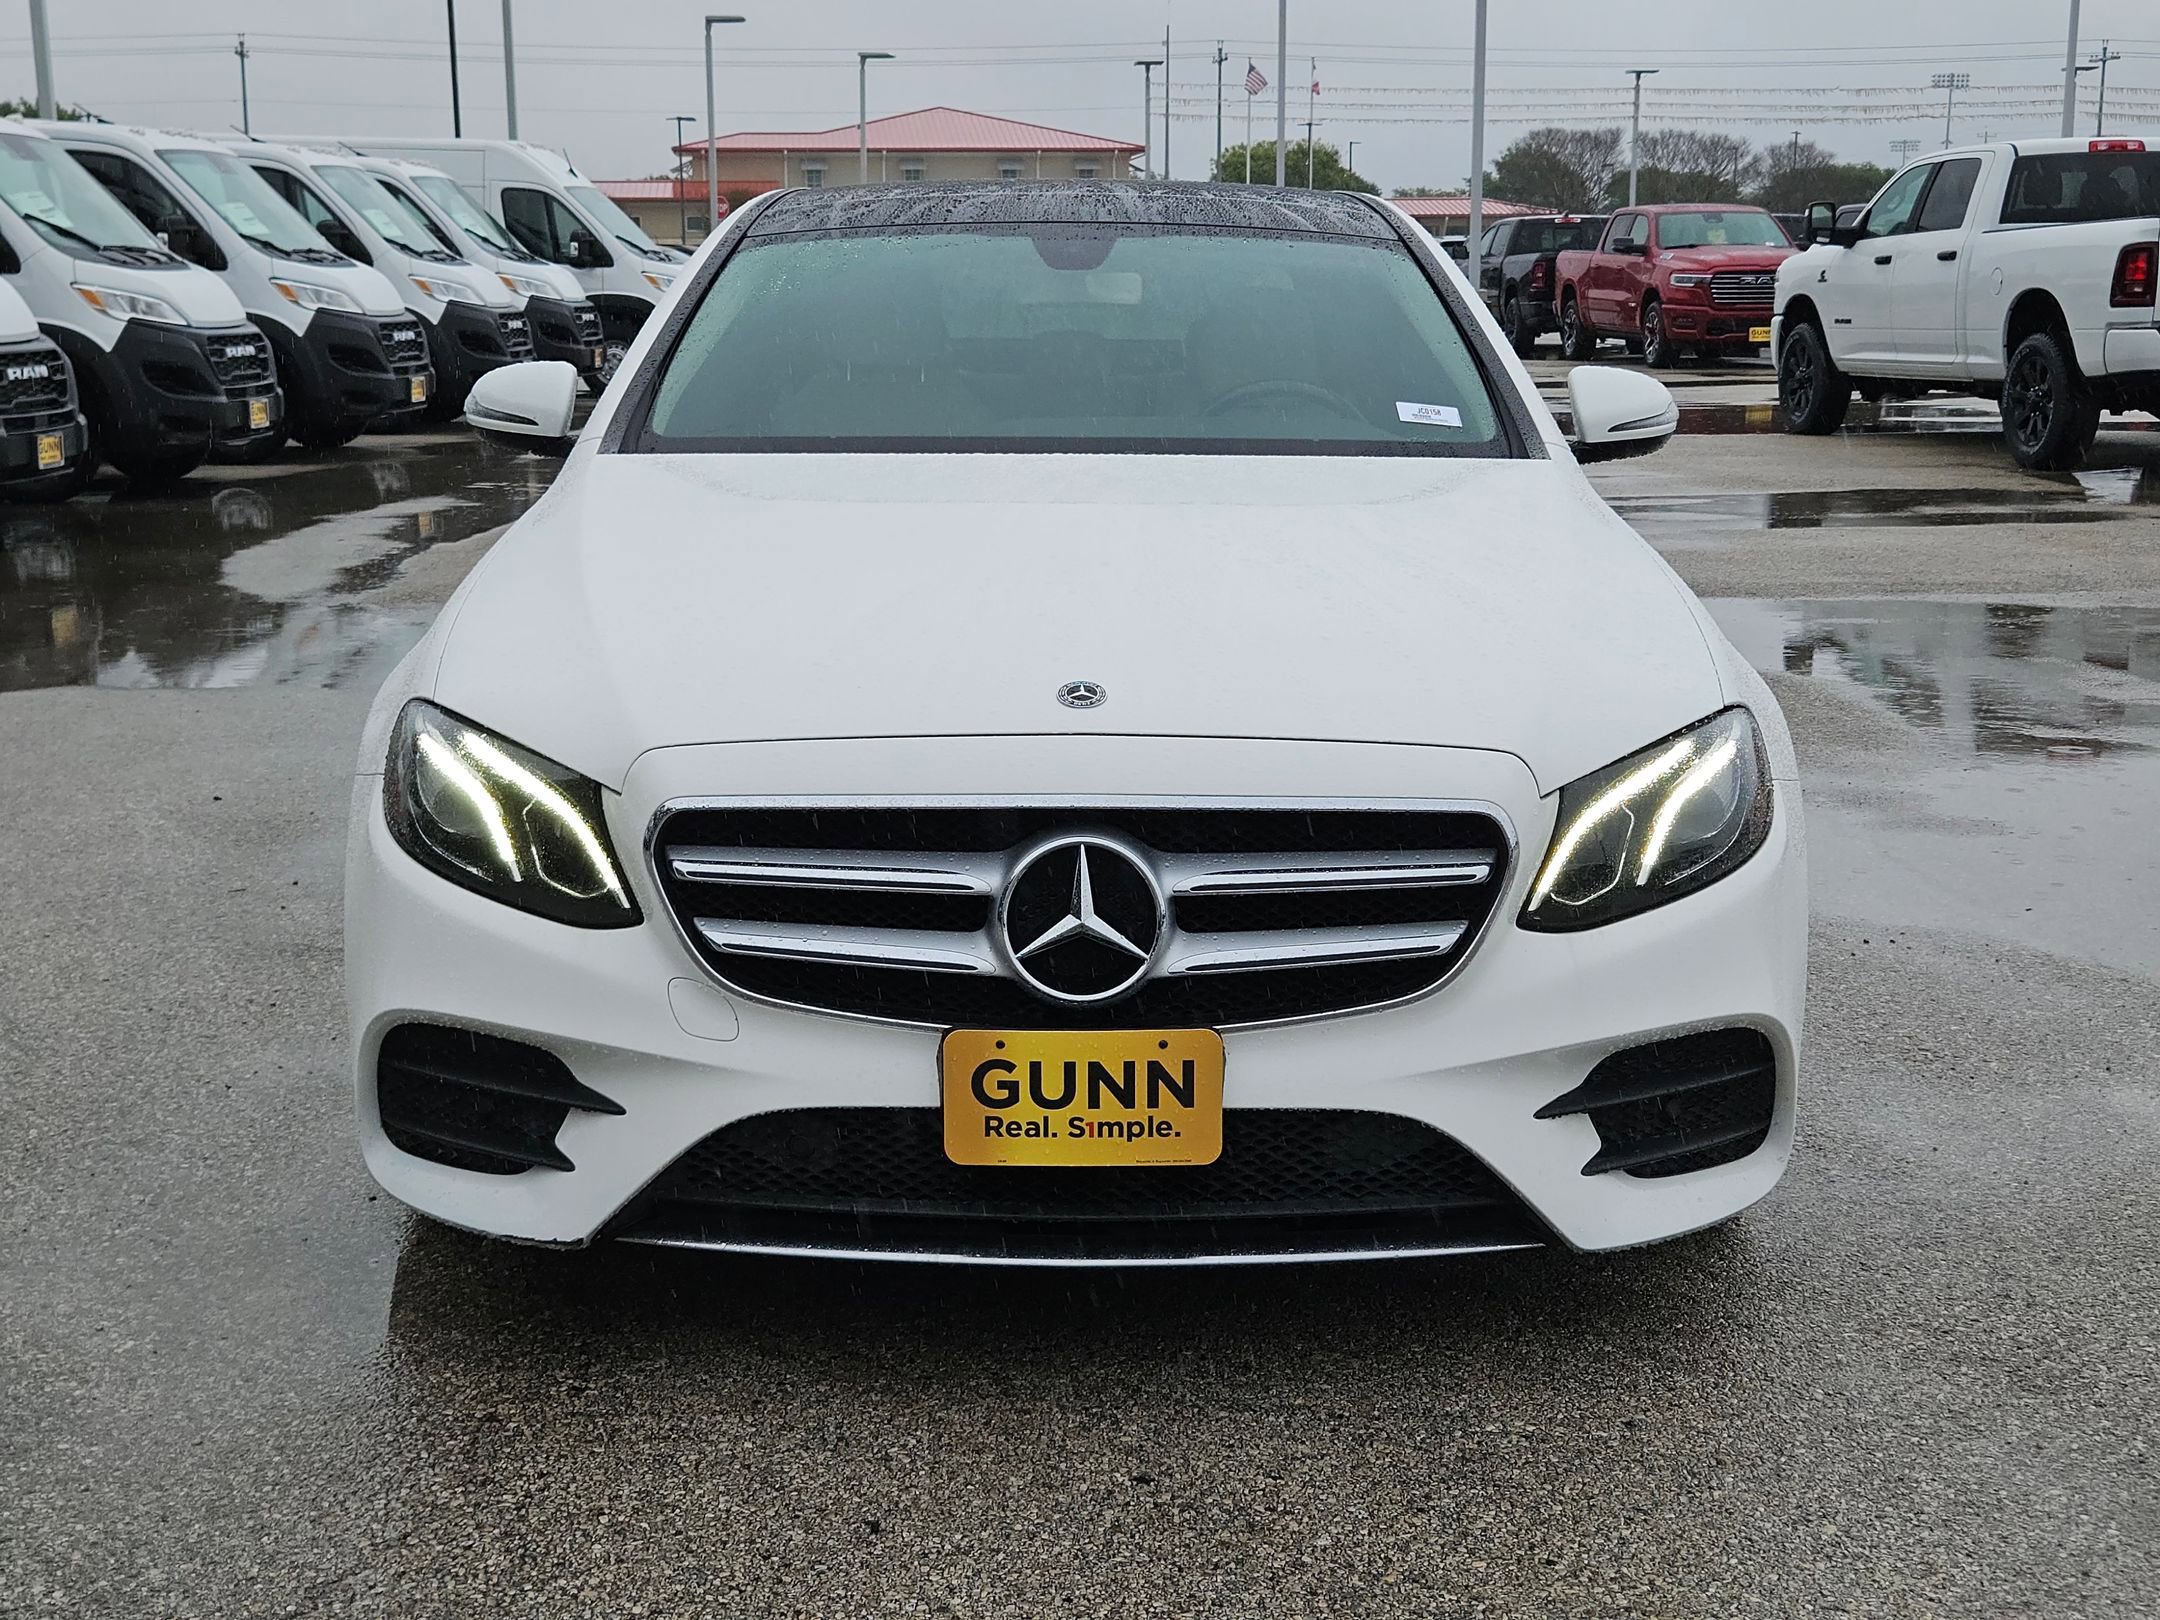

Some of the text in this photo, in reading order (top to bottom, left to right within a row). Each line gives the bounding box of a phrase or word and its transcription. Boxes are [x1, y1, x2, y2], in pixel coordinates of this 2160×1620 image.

[225, 345, 256, 358] RAM
[7, 365, 48, 380] RAM
[970, 1058, 1195, 1110] GUNN
[984, 1115, 1058, 1138] Real.
